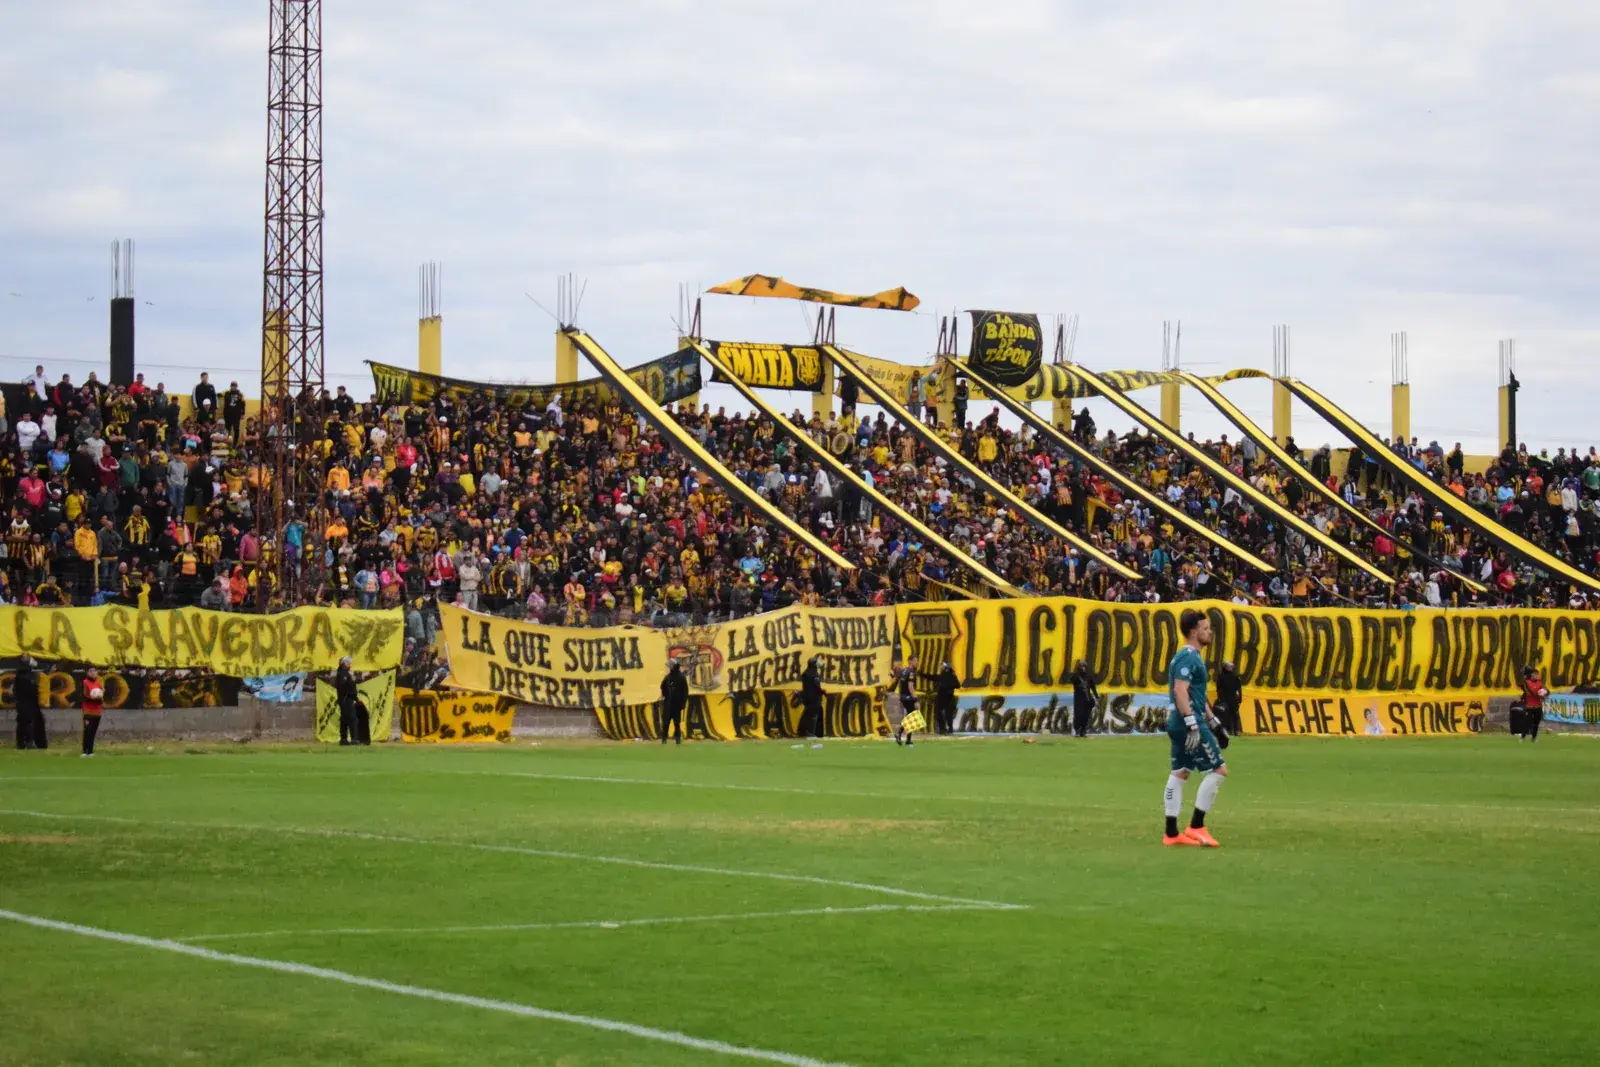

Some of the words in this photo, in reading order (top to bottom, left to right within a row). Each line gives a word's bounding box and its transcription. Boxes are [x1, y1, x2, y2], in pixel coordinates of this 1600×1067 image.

[985, 322, 1036, 341] BANDA
[15, 609, 82, 658] LA
[102, 606, 338, 664] SAAVEDRA
[461, 615, 496, 656] LA
[504, 629, 552, 670] QUE
[563, 635, 644, 674] SUENA
[727, 625, 760, 662] LA
[762, 612, 805, 655] QUE
[808, 613, 892, 650] ENVIDIA
[961, 606, 1016, 688] LA
[1232, 609, 1354, 690] BANDA
[1356, 613, 1420, 691] DEL
[1425, 612, 1600, 690] AURINEGR
[488, 661, 626, 708] DIFERENTE
[727, 651, 803, 692] MUCHA
[817, 652, 880, 687] GENTE
